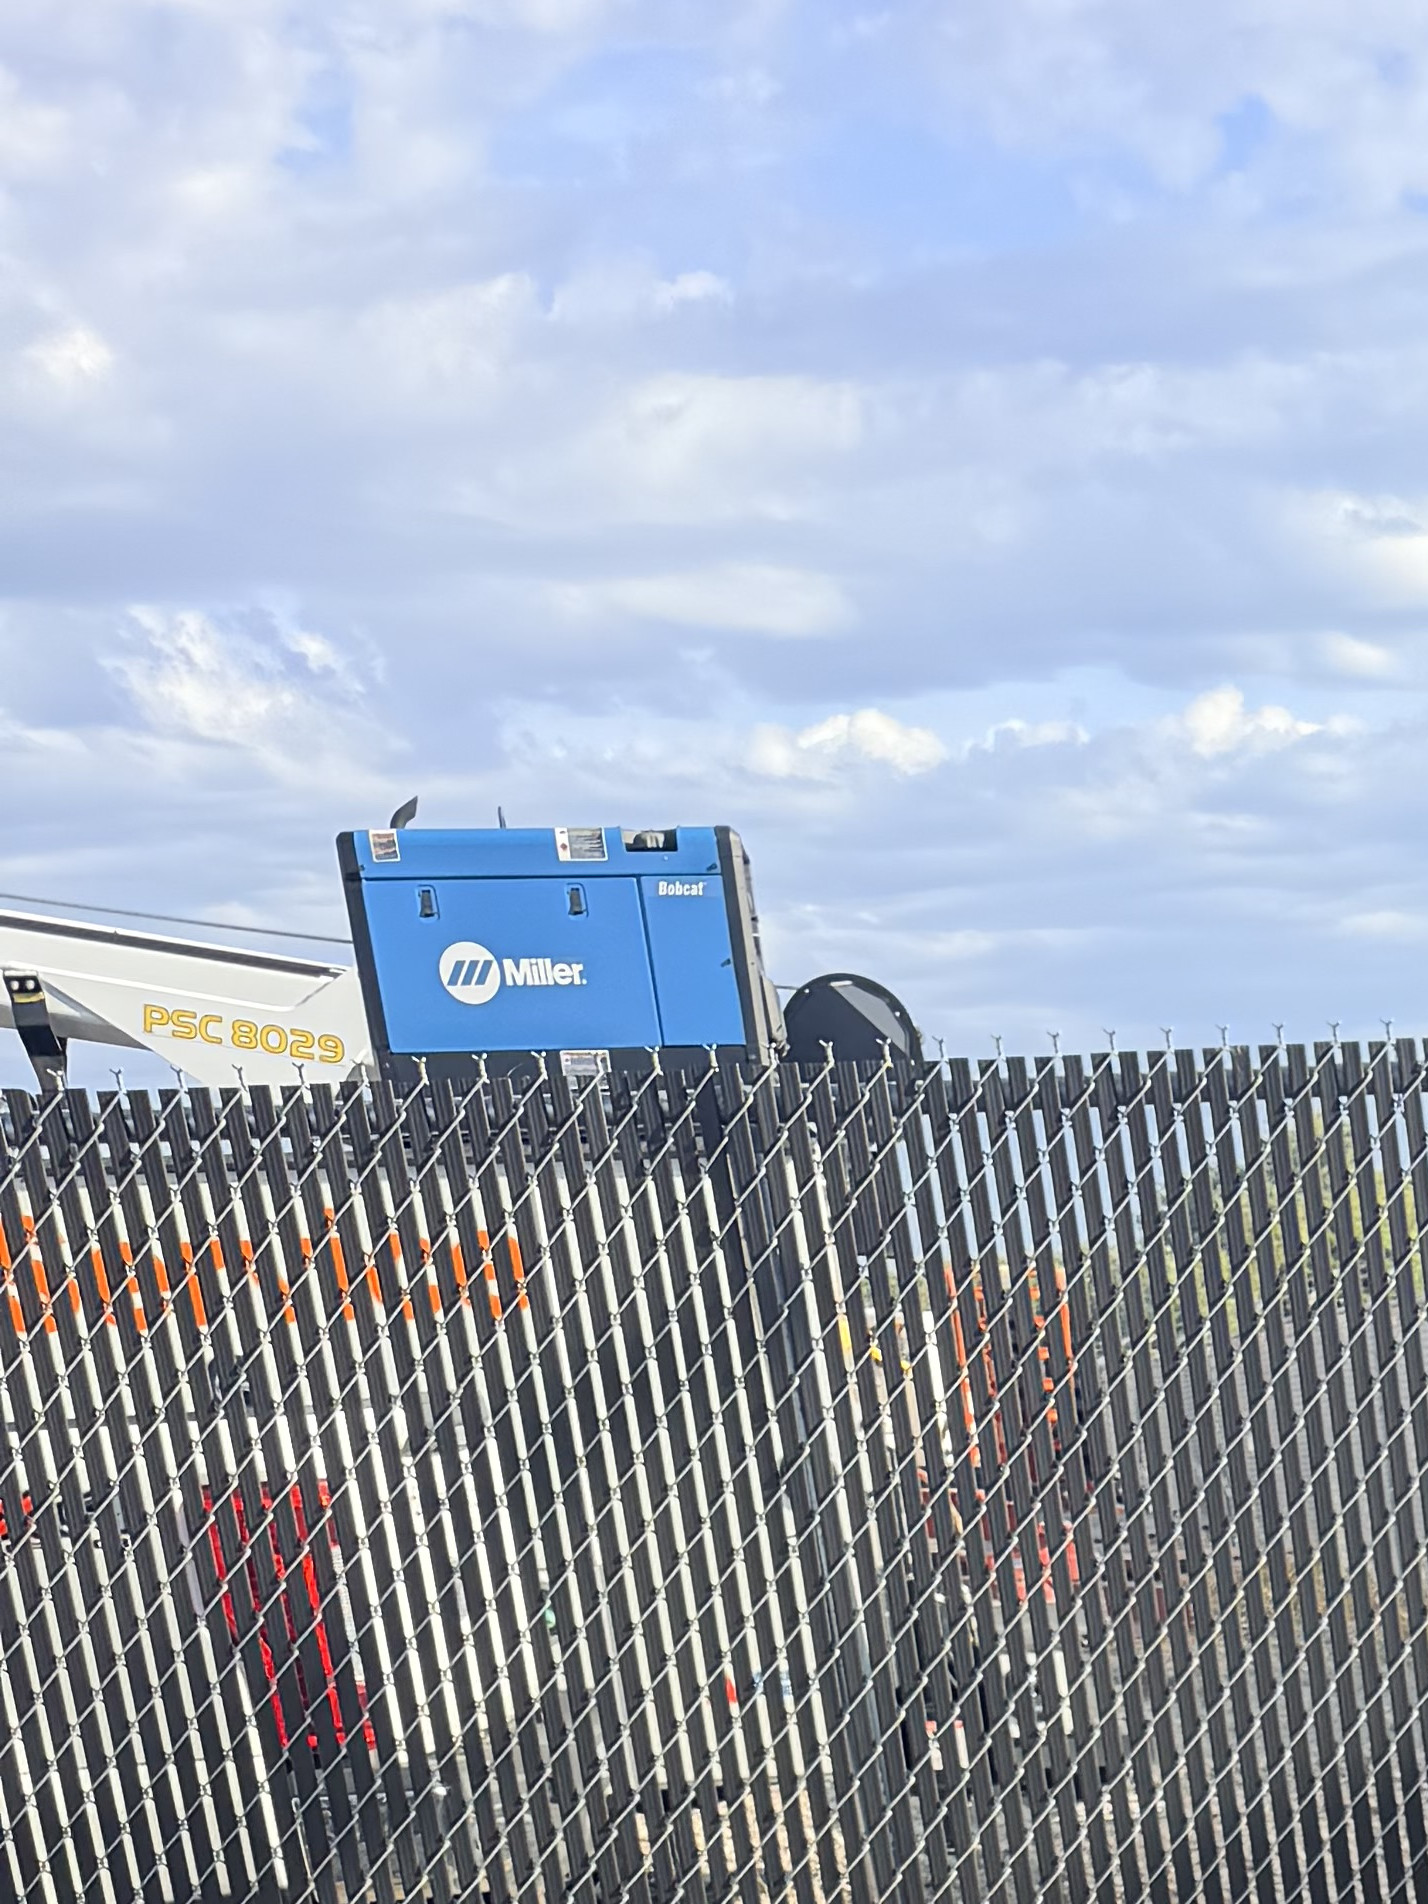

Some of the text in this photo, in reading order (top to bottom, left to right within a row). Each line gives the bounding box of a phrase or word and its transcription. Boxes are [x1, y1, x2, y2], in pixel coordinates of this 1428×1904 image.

[658, 880, 704, 896] Bobcat
[143, 1003, 346, 1064] PSC 8029
